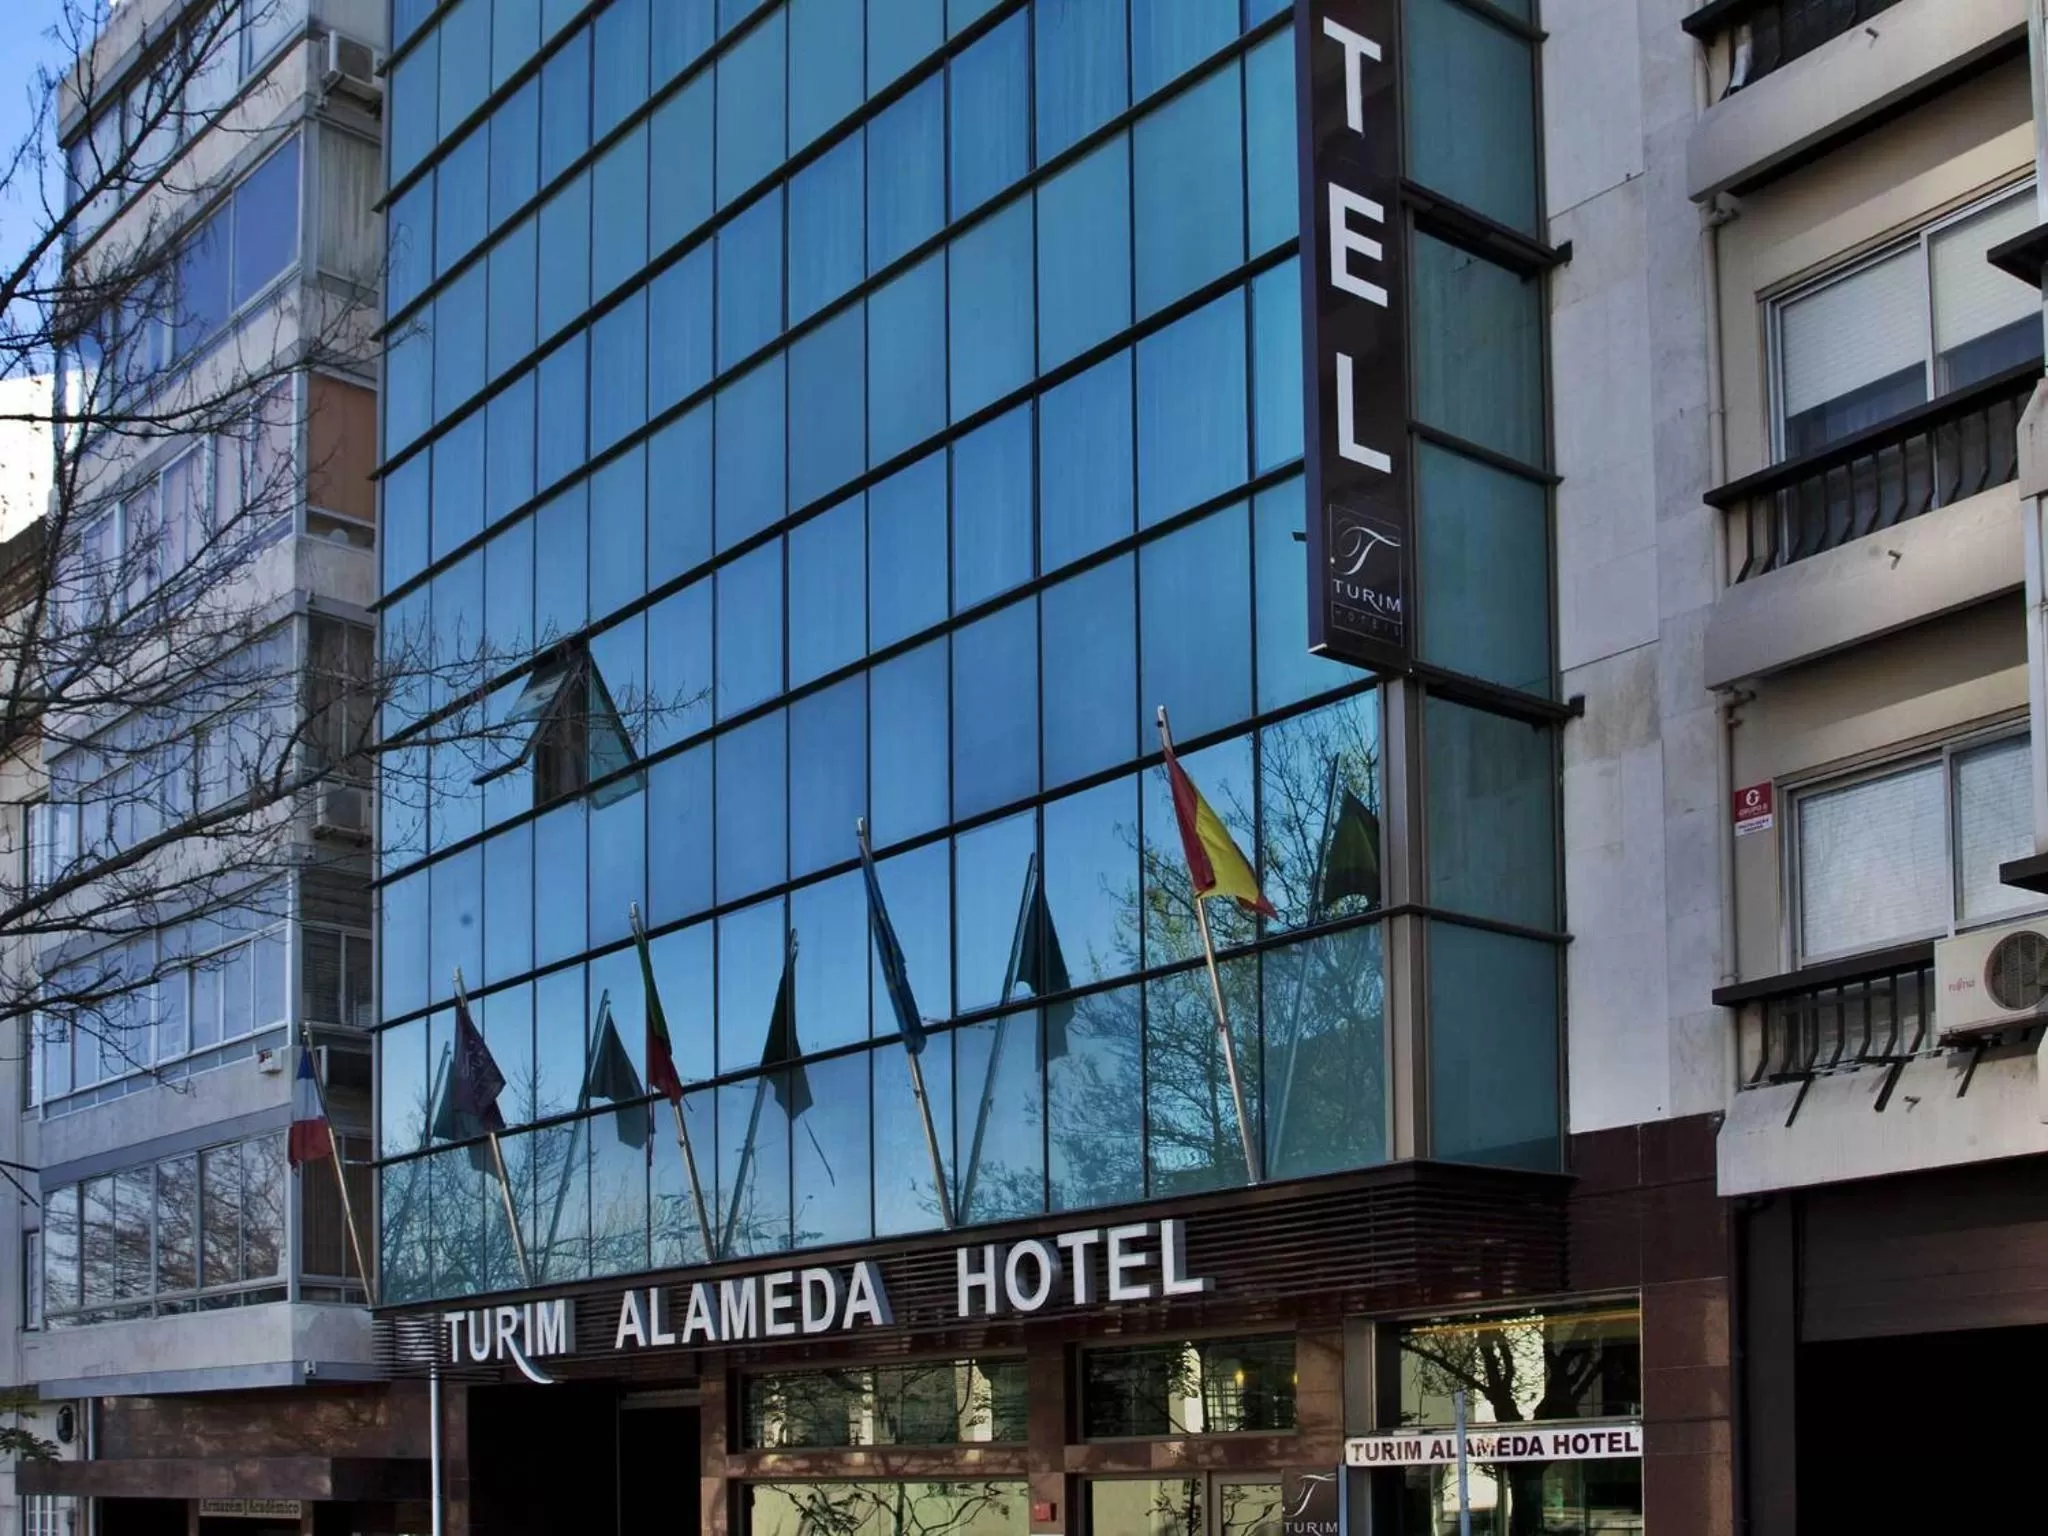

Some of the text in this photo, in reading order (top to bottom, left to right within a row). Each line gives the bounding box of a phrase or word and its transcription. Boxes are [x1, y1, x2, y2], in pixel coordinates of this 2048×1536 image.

[1333, 579, 1401, 614] TURIM
[444, 1218, 1214, 1384] TURIM ALAMEDA HOTEL
[1351, 1431, 1639, 1462] TURIM ALAMEDA HOTEL
[1284, 1521, 1338, 1536] TURIM
